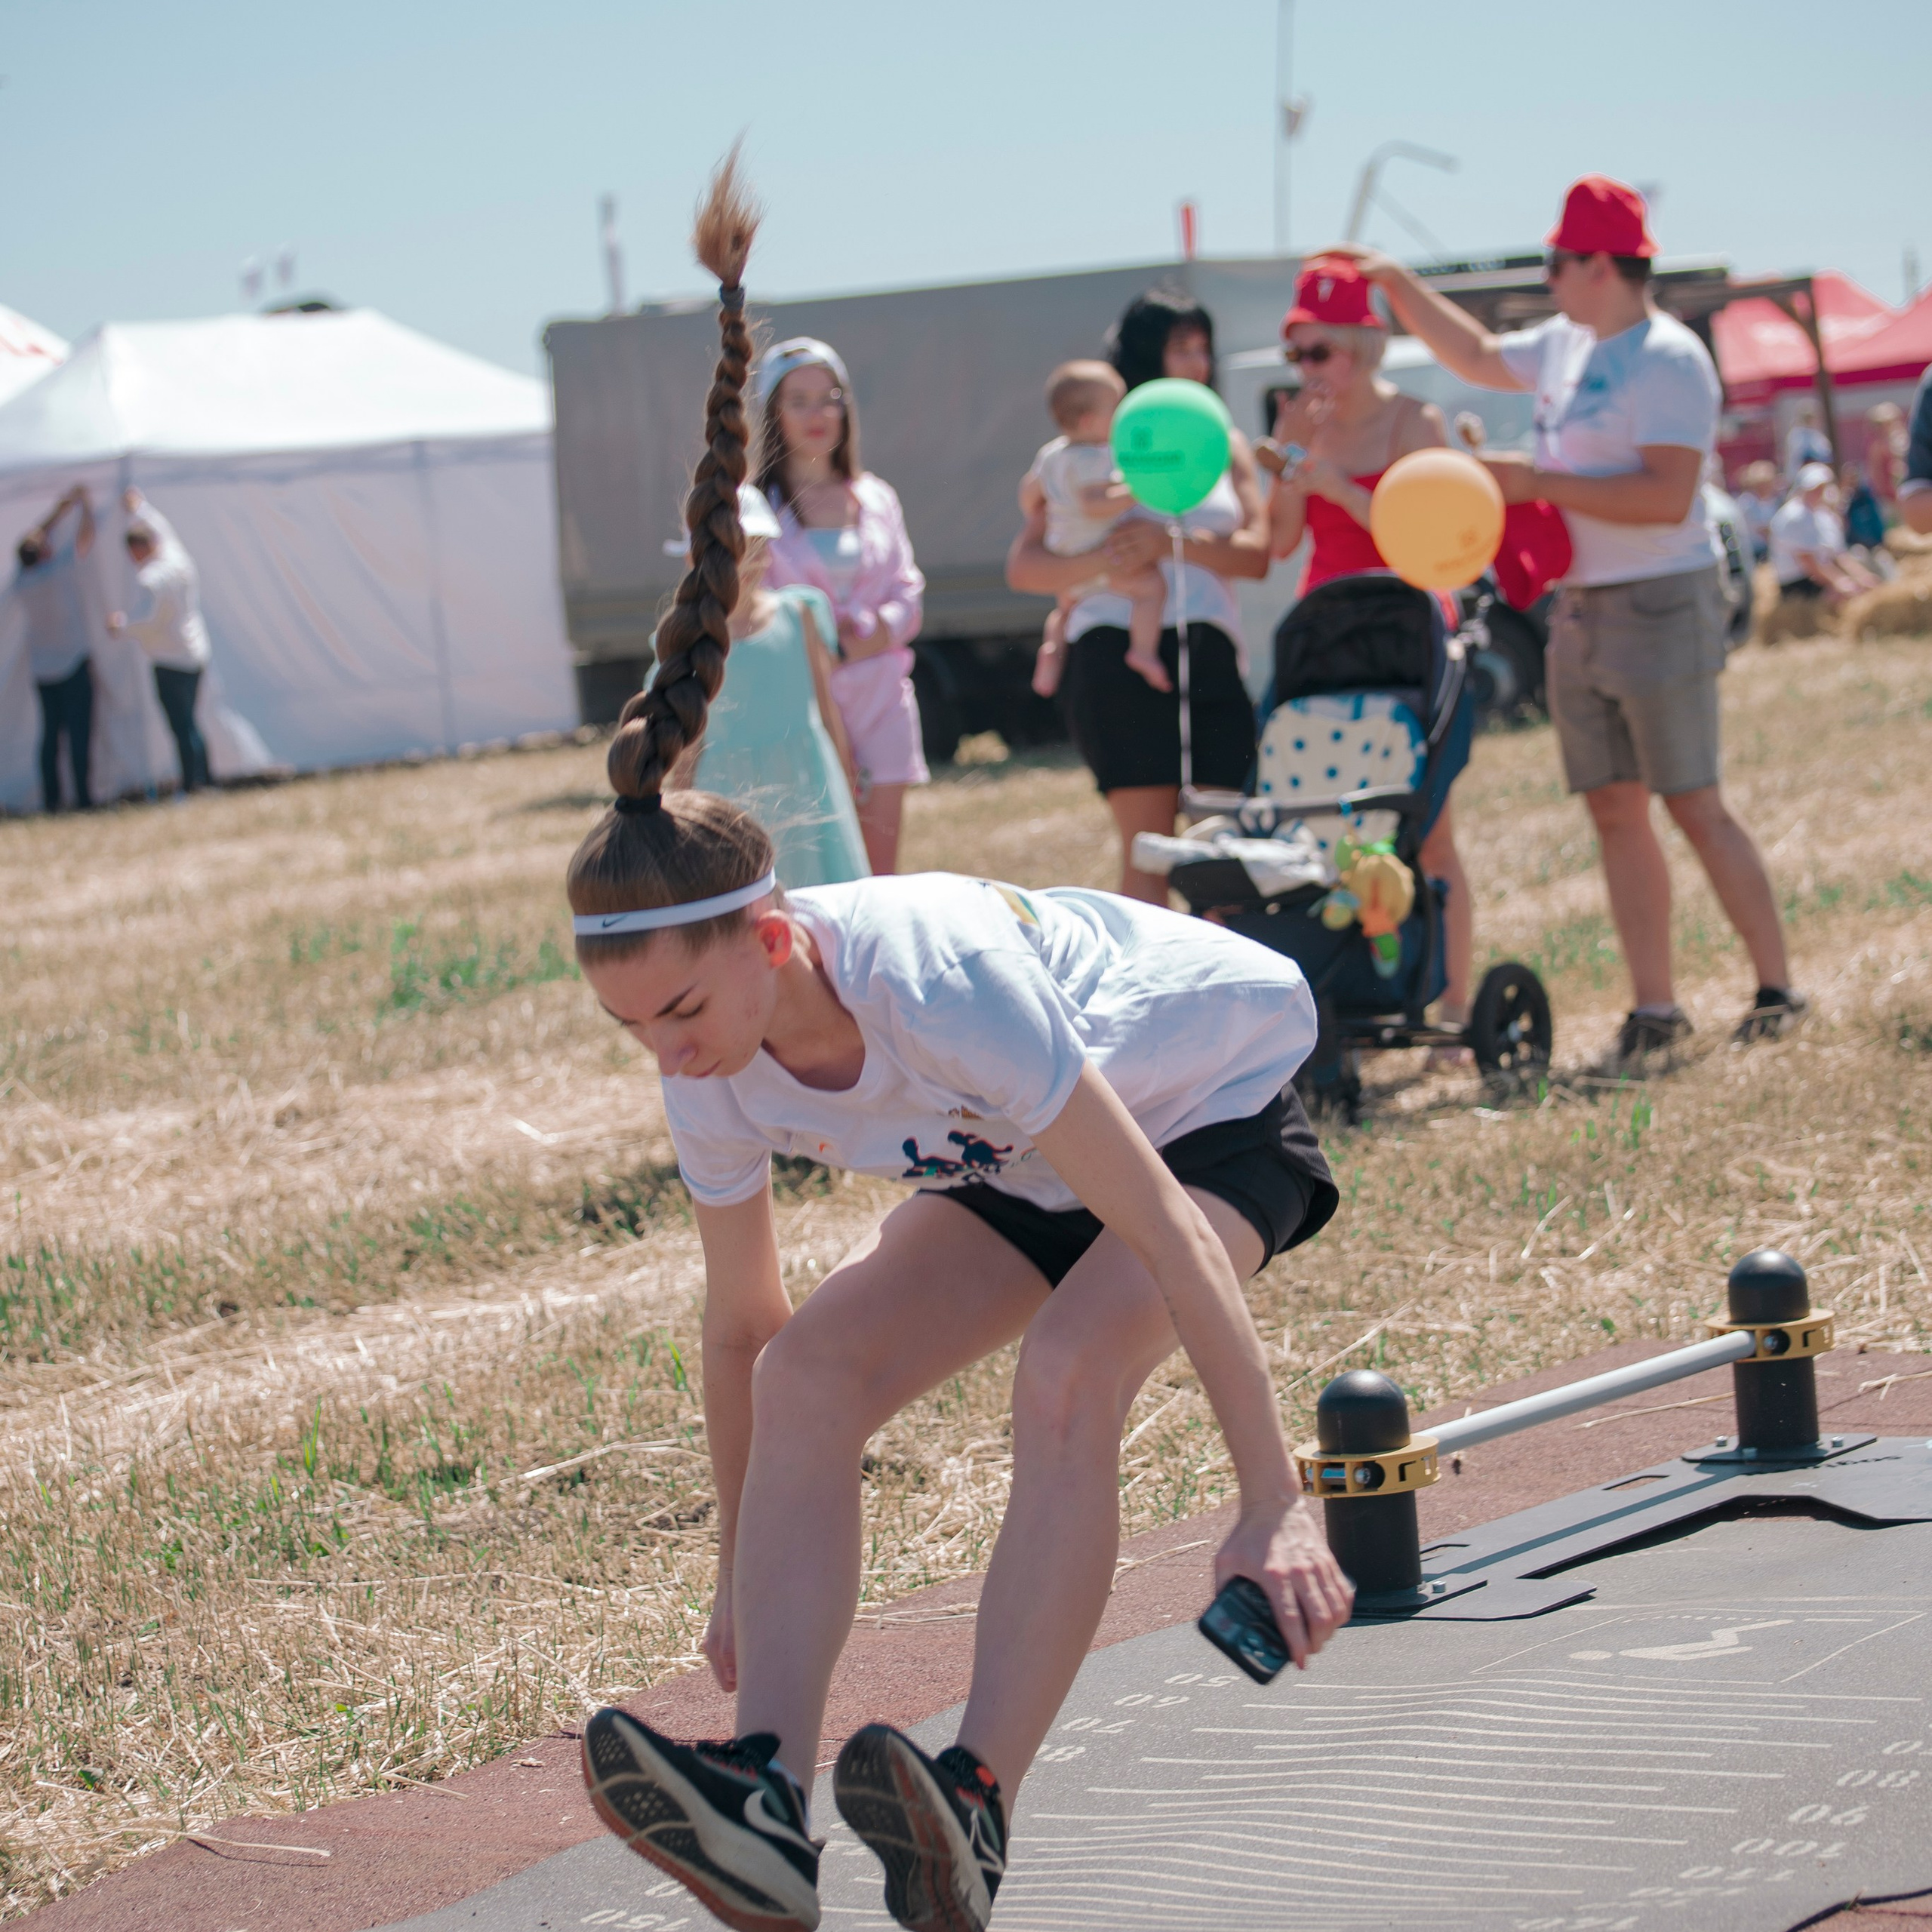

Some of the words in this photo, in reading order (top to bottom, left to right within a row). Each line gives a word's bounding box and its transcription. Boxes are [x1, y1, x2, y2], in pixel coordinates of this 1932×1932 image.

[1164, 1673, 1240, 1687] 50
[1113, 1694, 1190, 1708] 60
[1061, 1716, 1136, 1734] 70
[1835, 1768, 1921, 1789] 80
[1787, 1804, 1872, 1826] 90
[1730, 1838, 1847, 1858] 100
[1677, 1866, 1796, 1883] 110
[580, 1909, 692, 1932] 150
